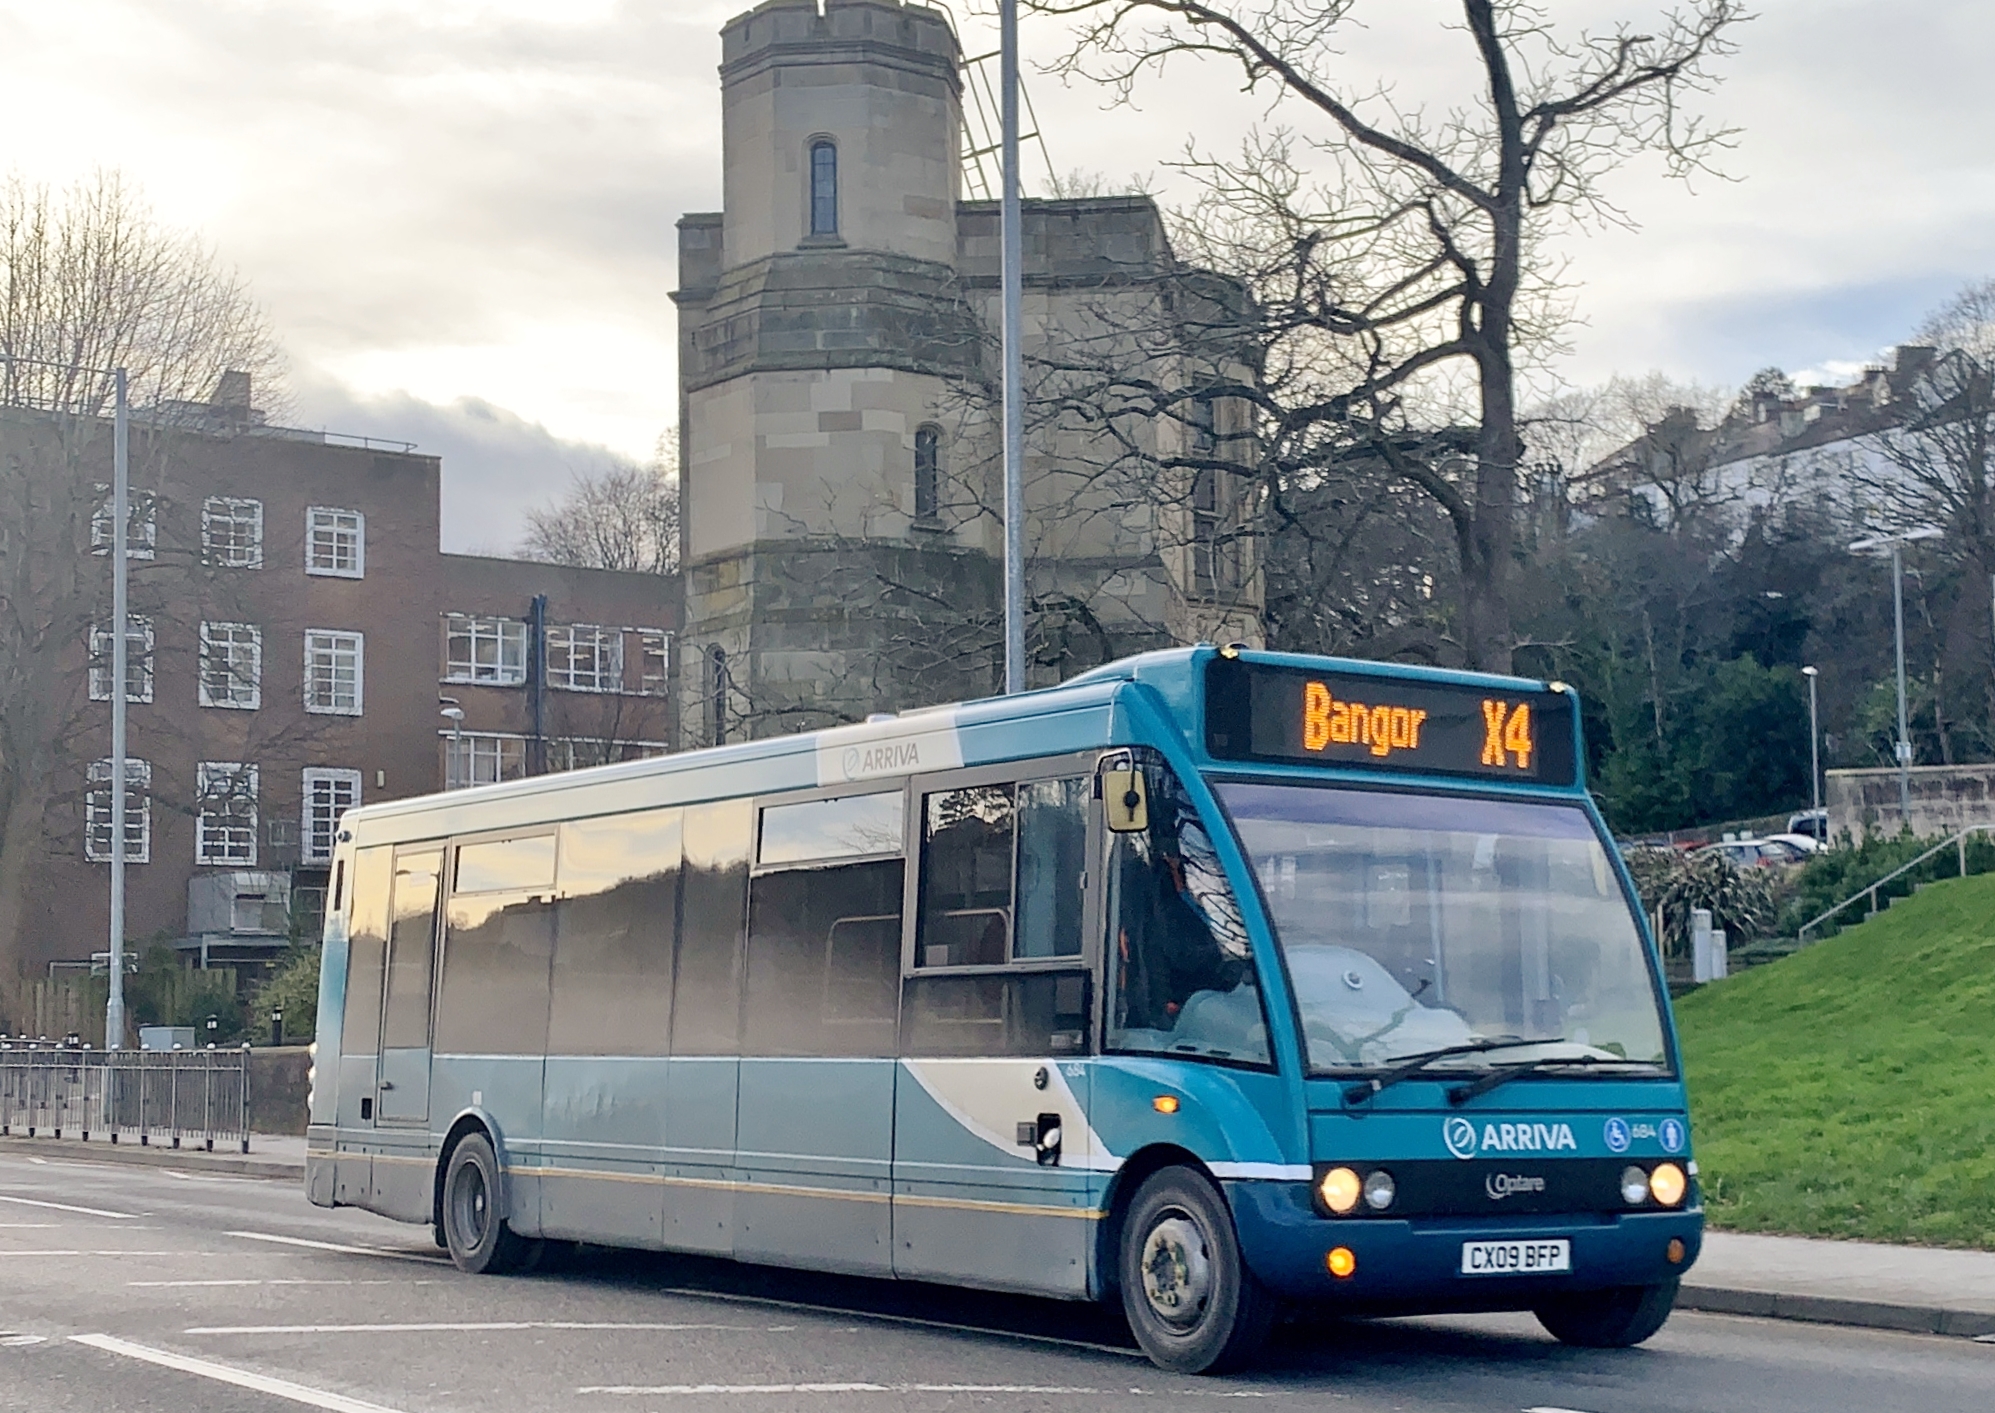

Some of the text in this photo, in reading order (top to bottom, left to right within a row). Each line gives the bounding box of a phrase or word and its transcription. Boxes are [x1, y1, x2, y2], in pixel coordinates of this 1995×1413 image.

[1304, 681, 1533, 769] Bangor X4
[862, 743, 919, 772] ARRIVA
[1481, 1123, 1577, 1150] ARRIVA
[1494, 1174, 1545, 1196] Optare
[1471, 1245, 1561, 1269] CX09 BFP
